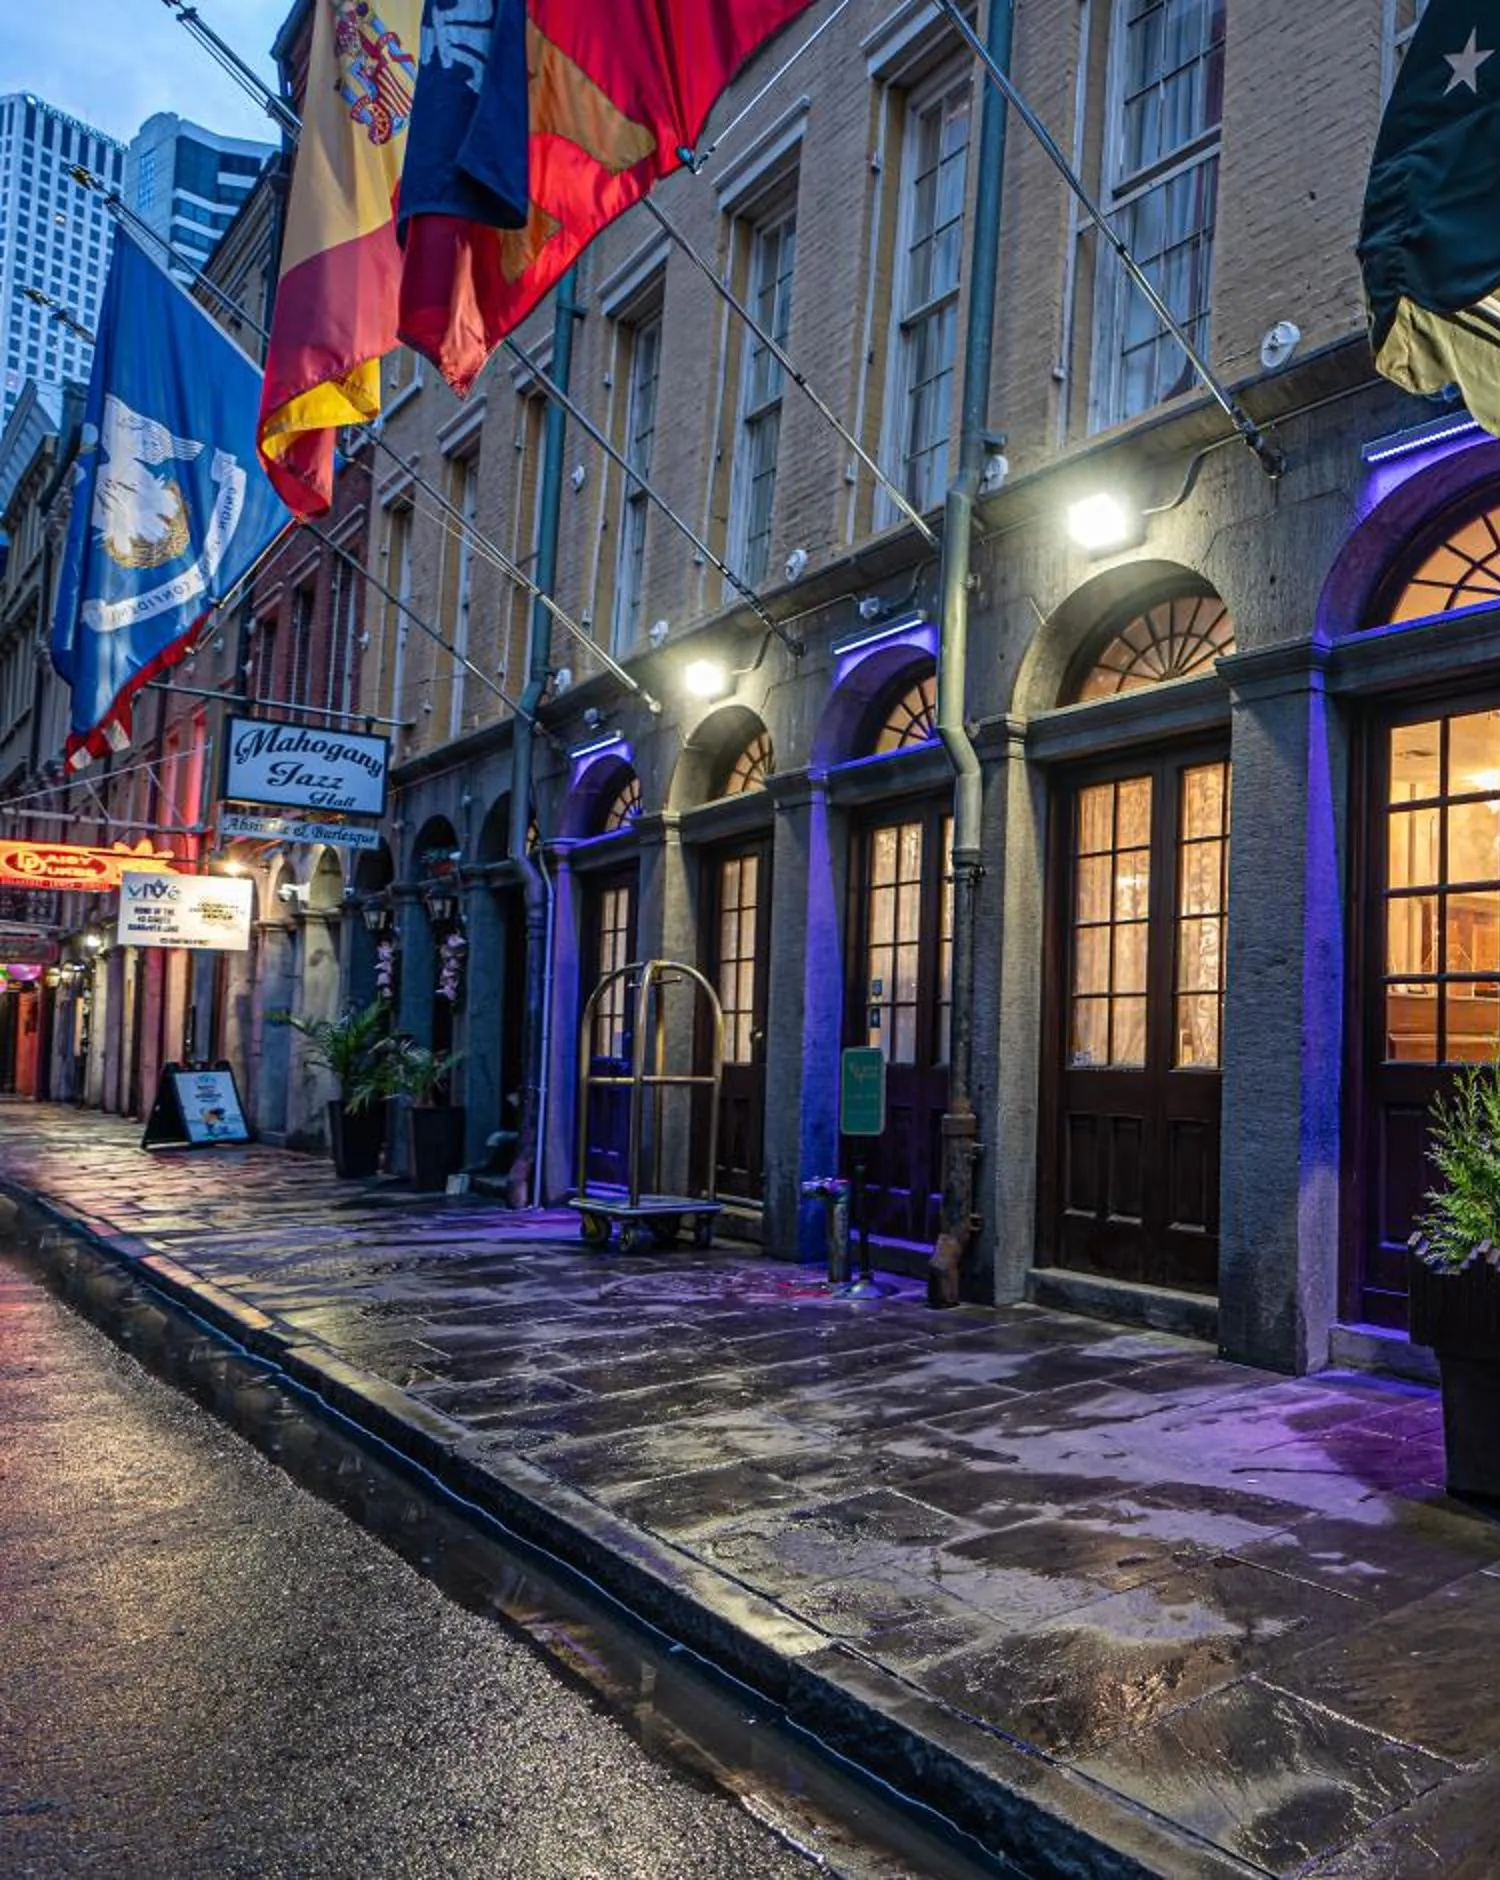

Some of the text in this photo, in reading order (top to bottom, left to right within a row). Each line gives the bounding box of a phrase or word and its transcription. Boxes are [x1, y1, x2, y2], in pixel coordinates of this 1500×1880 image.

[234, 726, 384, 778] Mahogany
[267, 761, 344, 790] Jazz
[309, 791, 357, 808] Hall
[312, 825, 376, 847] Burlesque
